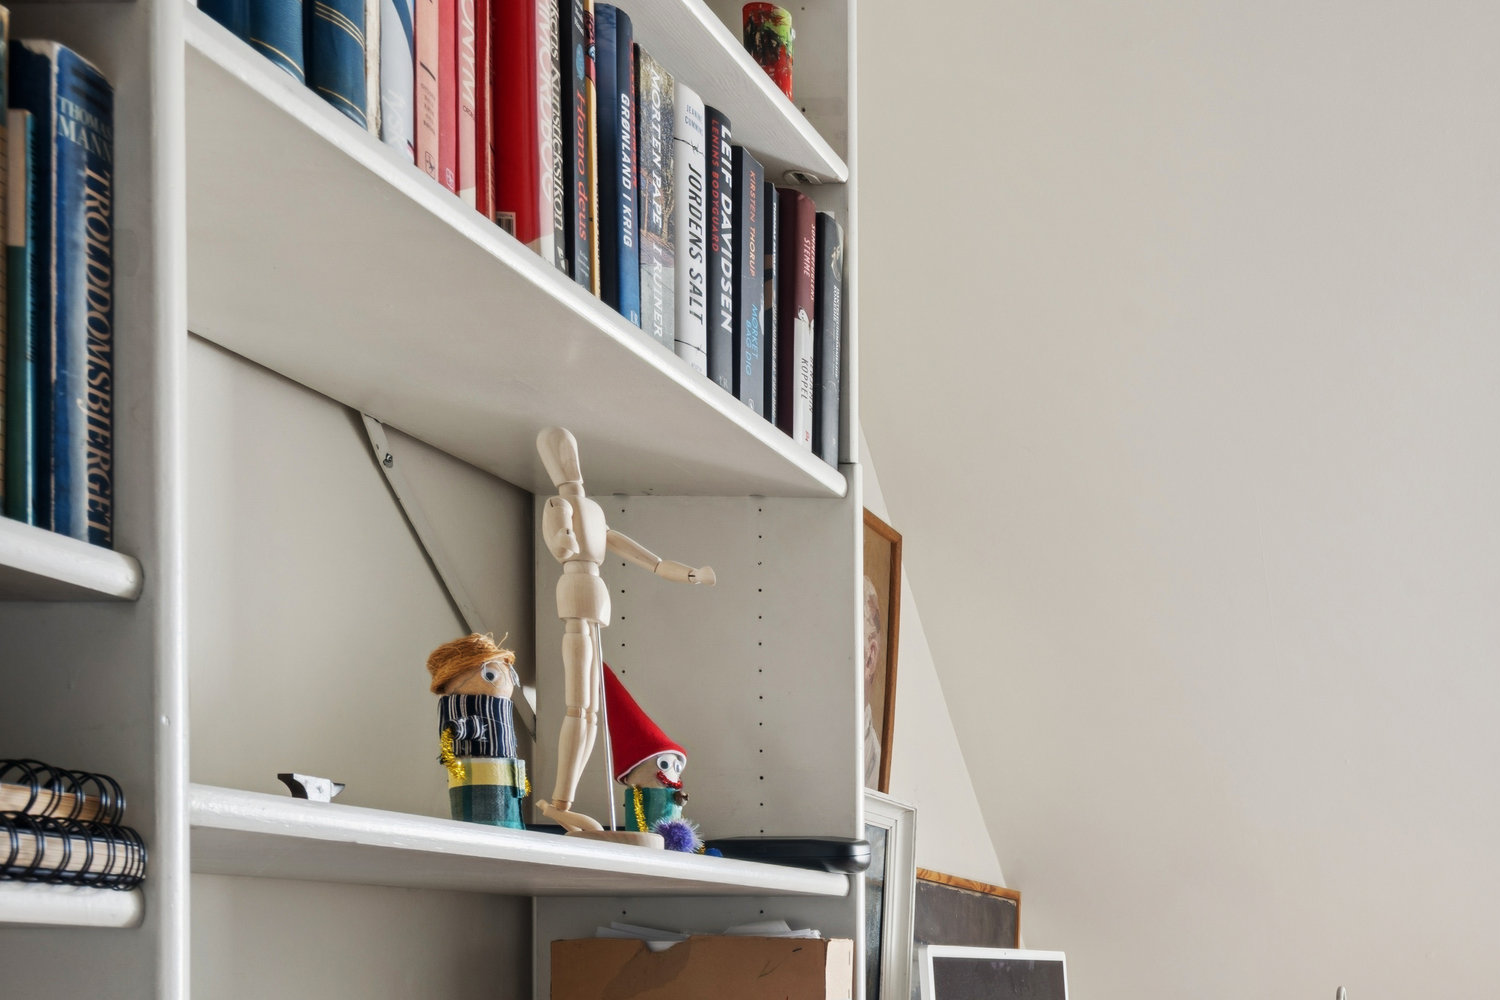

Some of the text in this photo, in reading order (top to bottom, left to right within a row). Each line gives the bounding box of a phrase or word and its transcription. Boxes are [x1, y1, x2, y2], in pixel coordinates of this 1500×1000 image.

[576, 90, 586, 176] Homo
[621, 92, 633, 249] GRØNLAND KRIG
[710, 119, 721, 253] LENINS BODYGUARD
[577, 181, 588, 242] deus
[649, 63, 663, 338] MORTEN PAPE RUINER
[688, 163, 704, 326] JORDENS SALT
[720, 124, 733, 334] LEIF DAVIDSEN
[749, 170, 757, 277] KIRSTEN THORUP
[803, 237, 811, 278] STEMME
[800, 356, 809, 401] KOPPEL
